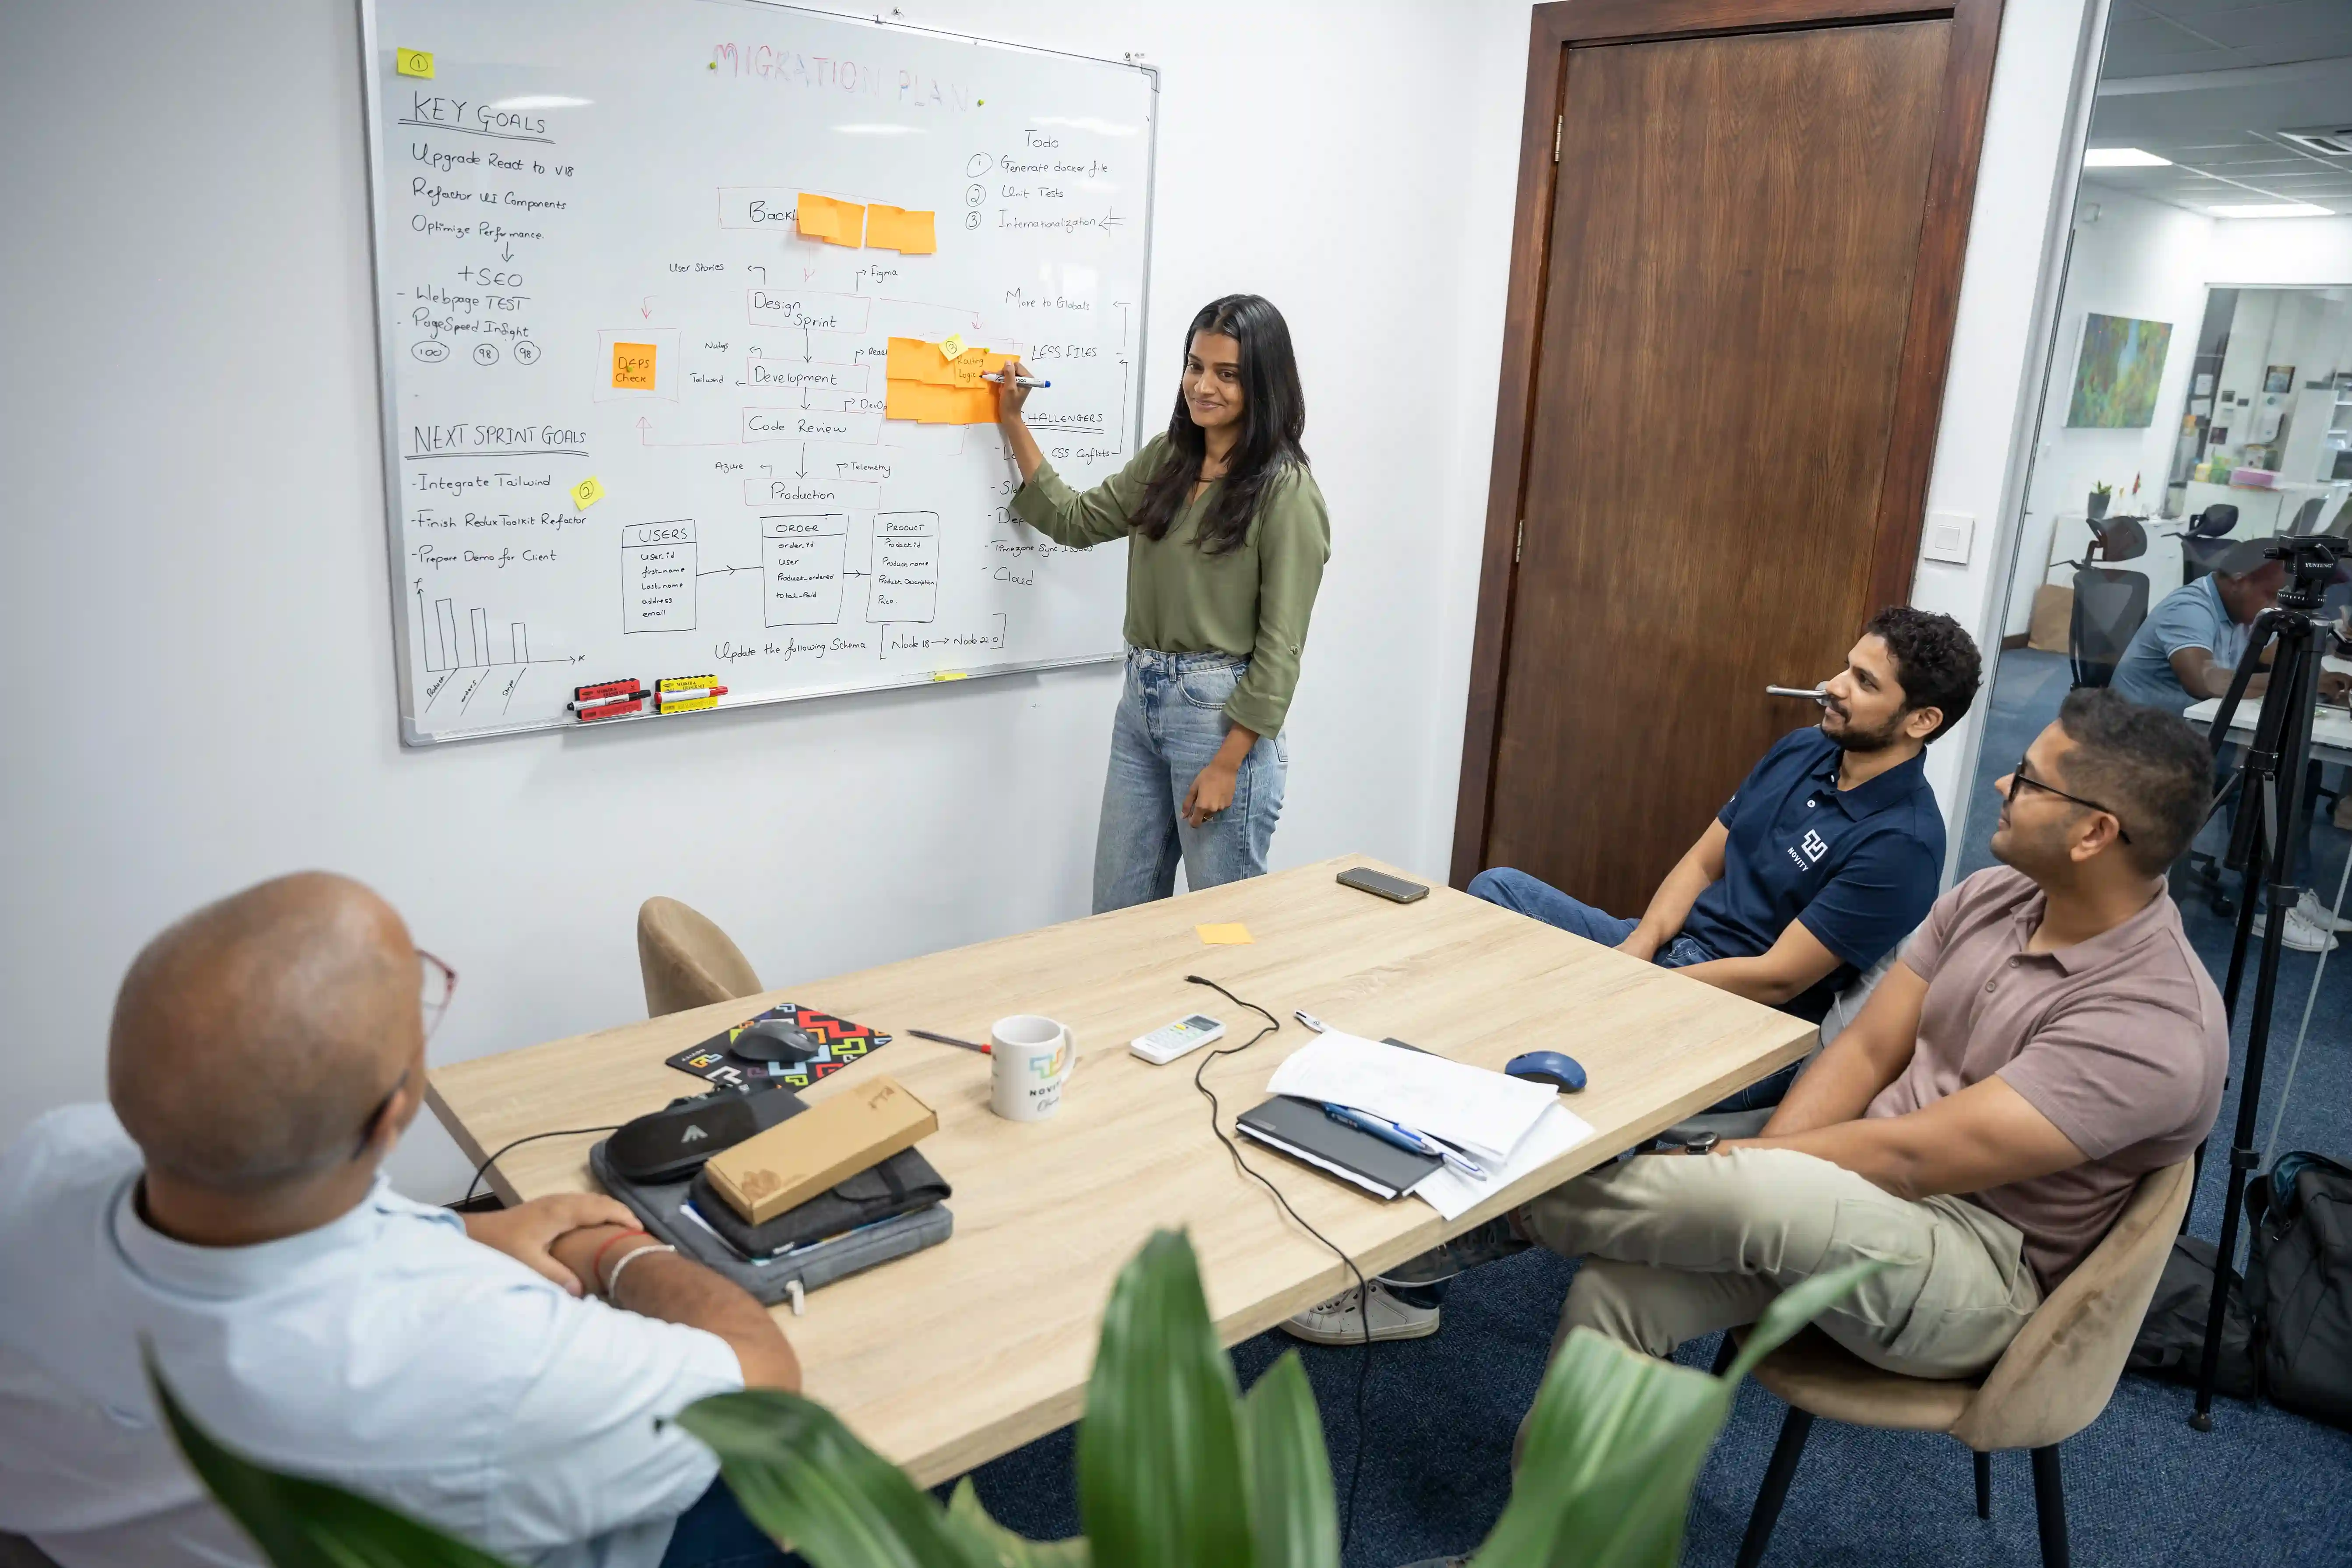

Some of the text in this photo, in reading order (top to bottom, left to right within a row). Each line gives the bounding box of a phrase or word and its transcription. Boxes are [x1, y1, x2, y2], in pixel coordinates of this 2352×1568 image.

[713, 43, 968, 112] MIGRATION PLAN
[415, 91, 545, 133] KEY GOALS
[1024, 130, 1059, 148] Todo
[413, 142, 480, 172] Upgrade
[489, 153, 524, 170] React
[533, 162, 545, 174] to
[1001, 155, 1049, 173] Generate
[1054, 161, 1085, 172] docker
[413, 177, 472, 206] Refactor
[505, 192, 566, 211] Components
[1002, 185, 1030, 198] Unit
[1038, 187, 1063, 198] Tests
[412, 215, 470, 238] Optimize
[999, 209, 1095, 233] Internationalization
[695, 263, 724, 271] Stories
[871, 265, 898, 283] Figma
[417, 284, 531, 314] Webpage TEST
[754, 292, 802, 318] Design
[1043, 297, 1051, 307] to
[1057, 297, 1090, 310] Globals
[793, 311, 837, 328] Sprint
[420, 348, 441, 357] 100
[1032, 345, 1097, 360] LESS FILES
[618, 357, 650, 369] DEPS
[616, 373, 646, 383] Check
[755, 366, 838, 387] Development
[959, 369, 976, 382] Logic
[861, 399, 886, 411] DevOp
[749, 415, 847, 433] Code Review
[415, 424, 586, 453] NEXT SPRINT GOALS
[1051, 448, 1070, 458] CSS
[1076, 448, 1109, 465] Conflicts
[715, 462, 743, 473] Azure
[851, 461, 890, 478] Telemetry
[494, 473, 550, 487] Tailwind
[771, 481, 834, 500] Production
[465, 513, 497, 527] Redux
[499, 515, 535, 526] Toolkit
[541, 513, 586, 531] Refactor
[887, 523, 925, 531] PRODUCT
[639, 528, 687, 542] USERS
[991, 540, 1034, 557] Timezone
[1038, 544, 1058, 557] Sync
[464, 551, 494, 562] Demo
[498, 547, 514, 569] for
[994, 567, 1033, 585] Cloud
[715, 637, 867, 663] Update the following Schema
[892, 633, 918, 649] Node
[954, 633, 977, 645] Node
[1787, 847, 1808, 871] NOVITY
[1030, 1080, 1060, 1096] NOVI
